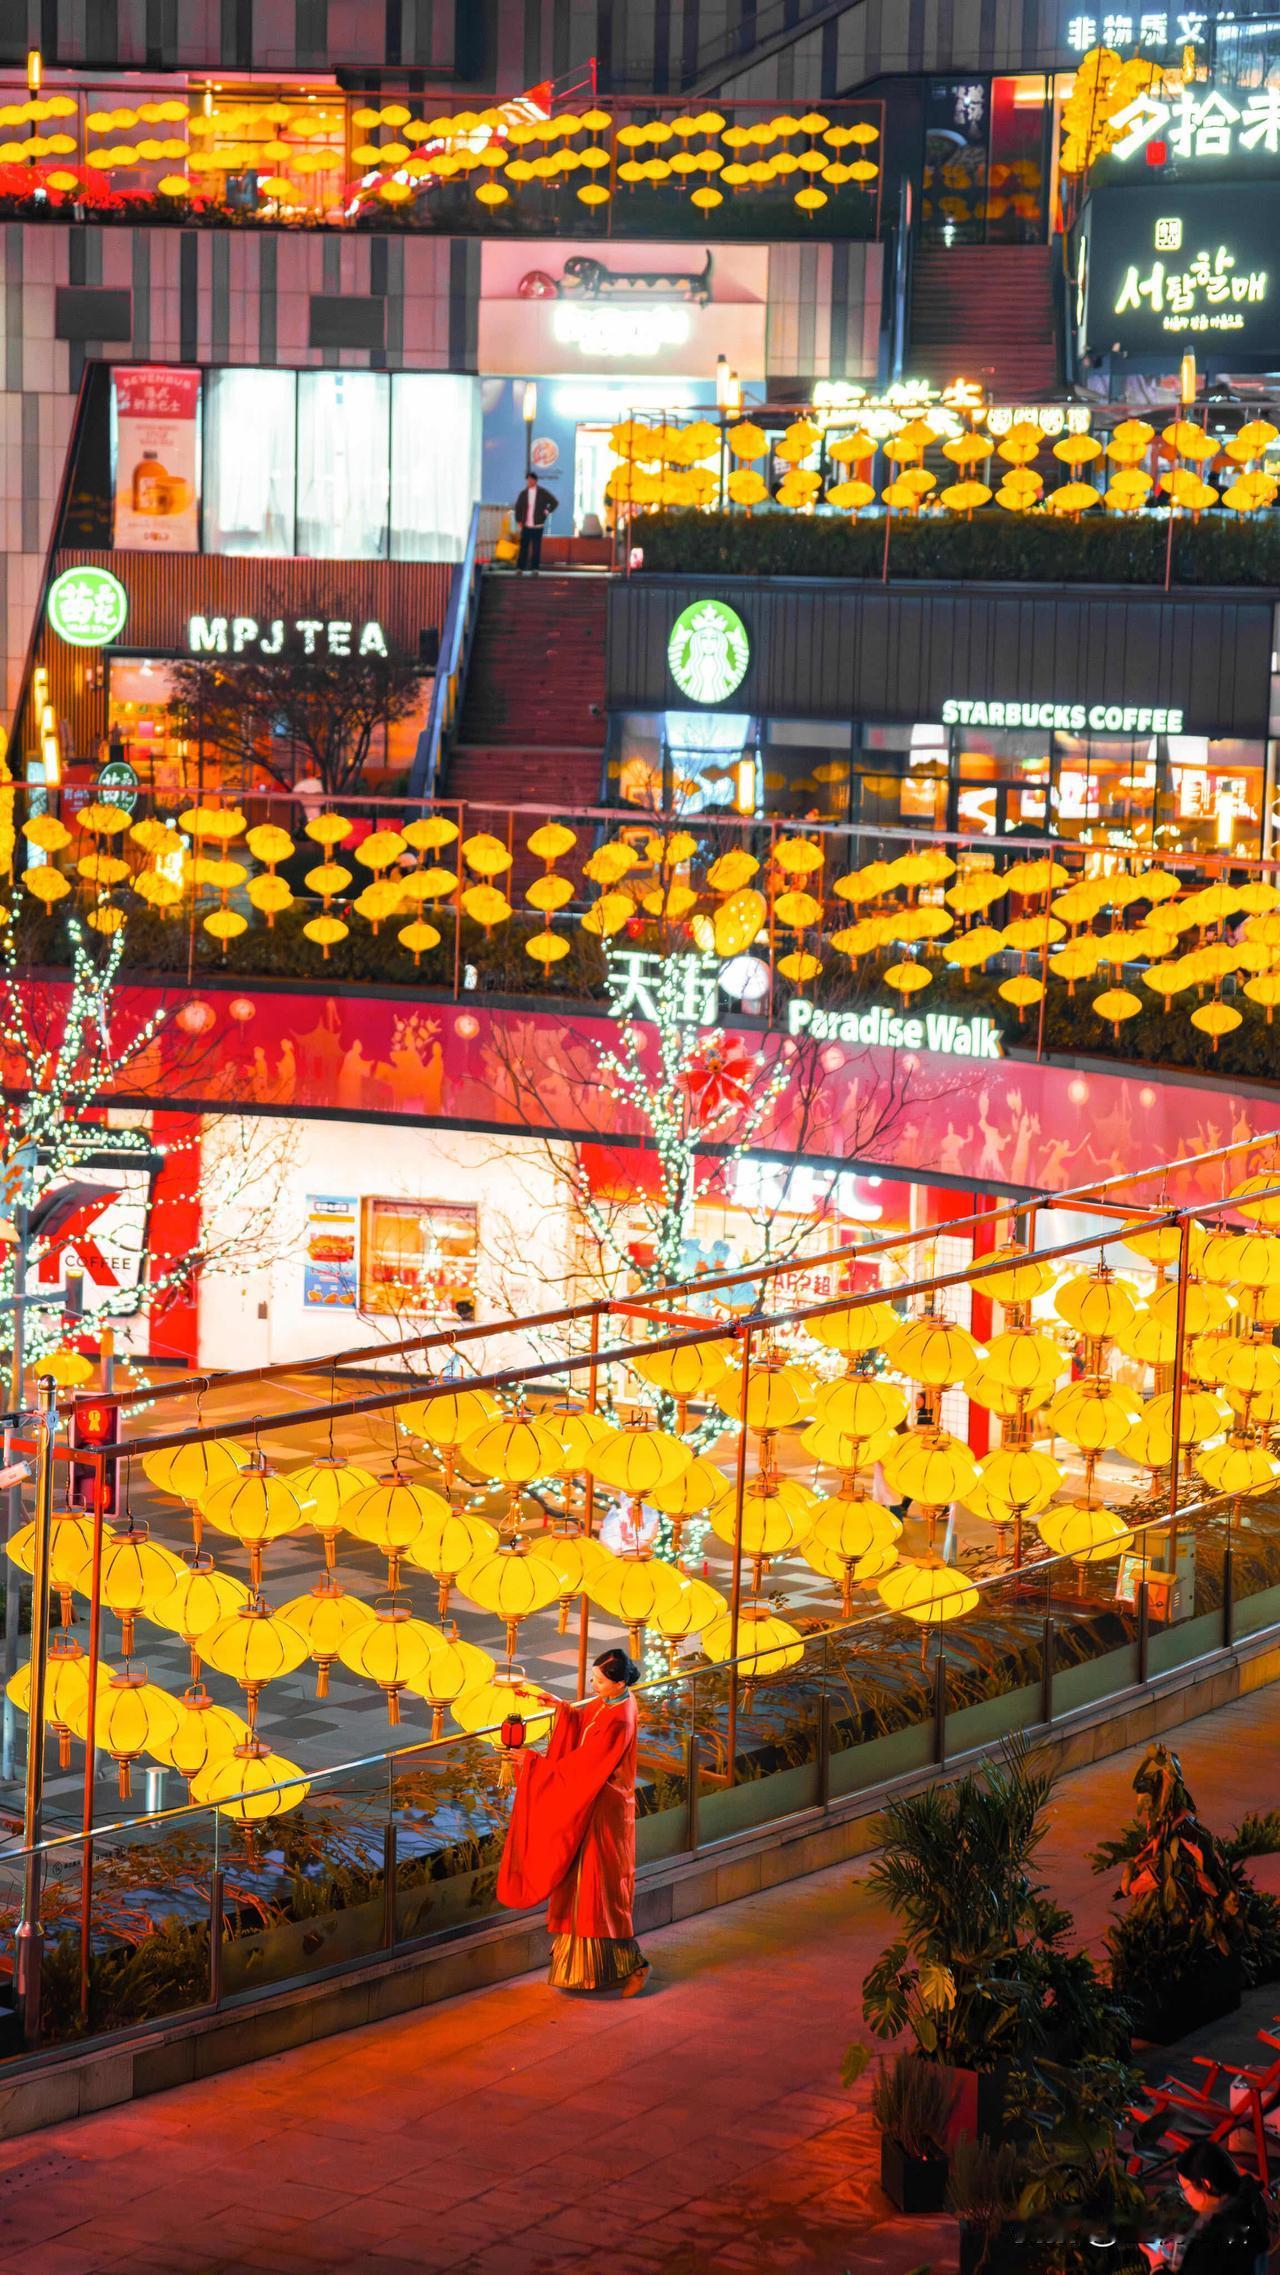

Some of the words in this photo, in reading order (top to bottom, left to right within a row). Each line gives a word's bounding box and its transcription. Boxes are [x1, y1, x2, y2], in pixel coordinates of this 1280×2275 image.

[1068, 11, 1236, 50] 非物质文
[189, 615, 284, 656] MPJ
[296, 620, 388, 657] TEA
[941, 699, 1087, 731] STARBUCKS
[1088, 706, 1184, 734] COFFEE
[607, 949, 720, 1027] 天街
[788, 999, 924, 1049] Paradise
[926, 1013, 1003, 1059] Walk
[65, 1254, 132, 1270] COFFEE
